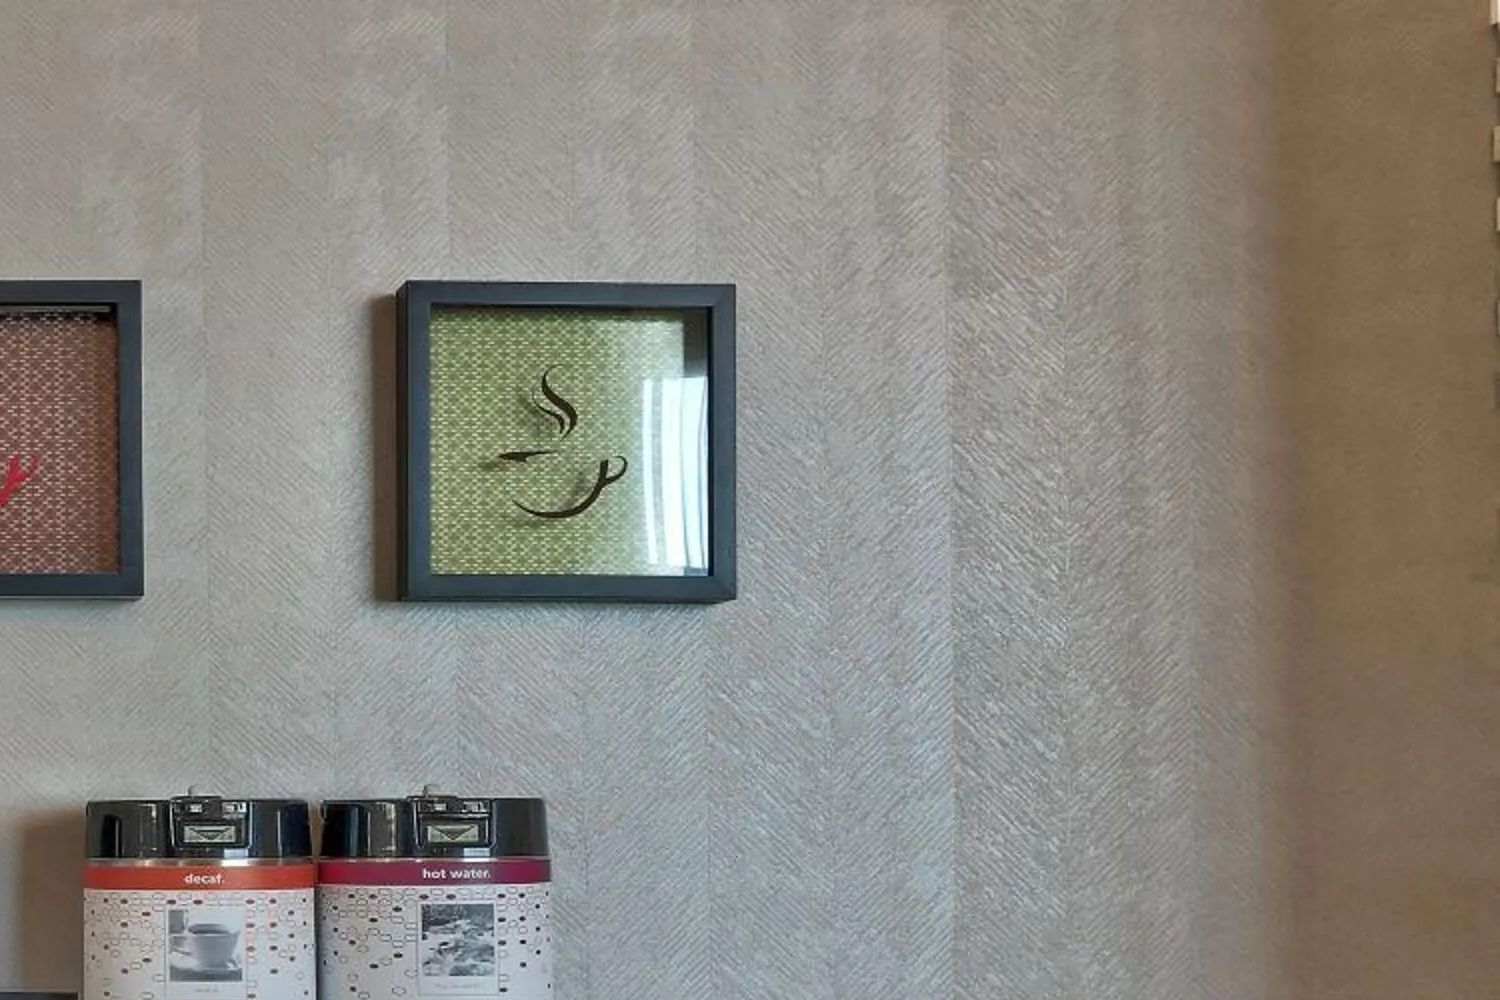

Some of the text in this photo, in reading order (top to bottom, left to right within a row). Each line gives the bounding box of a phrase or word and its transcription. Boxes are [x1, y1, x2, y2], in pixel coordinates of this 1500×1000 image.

[184, 873, 224, 884] decaf.
[422, 868, 491, 879] hot water.
